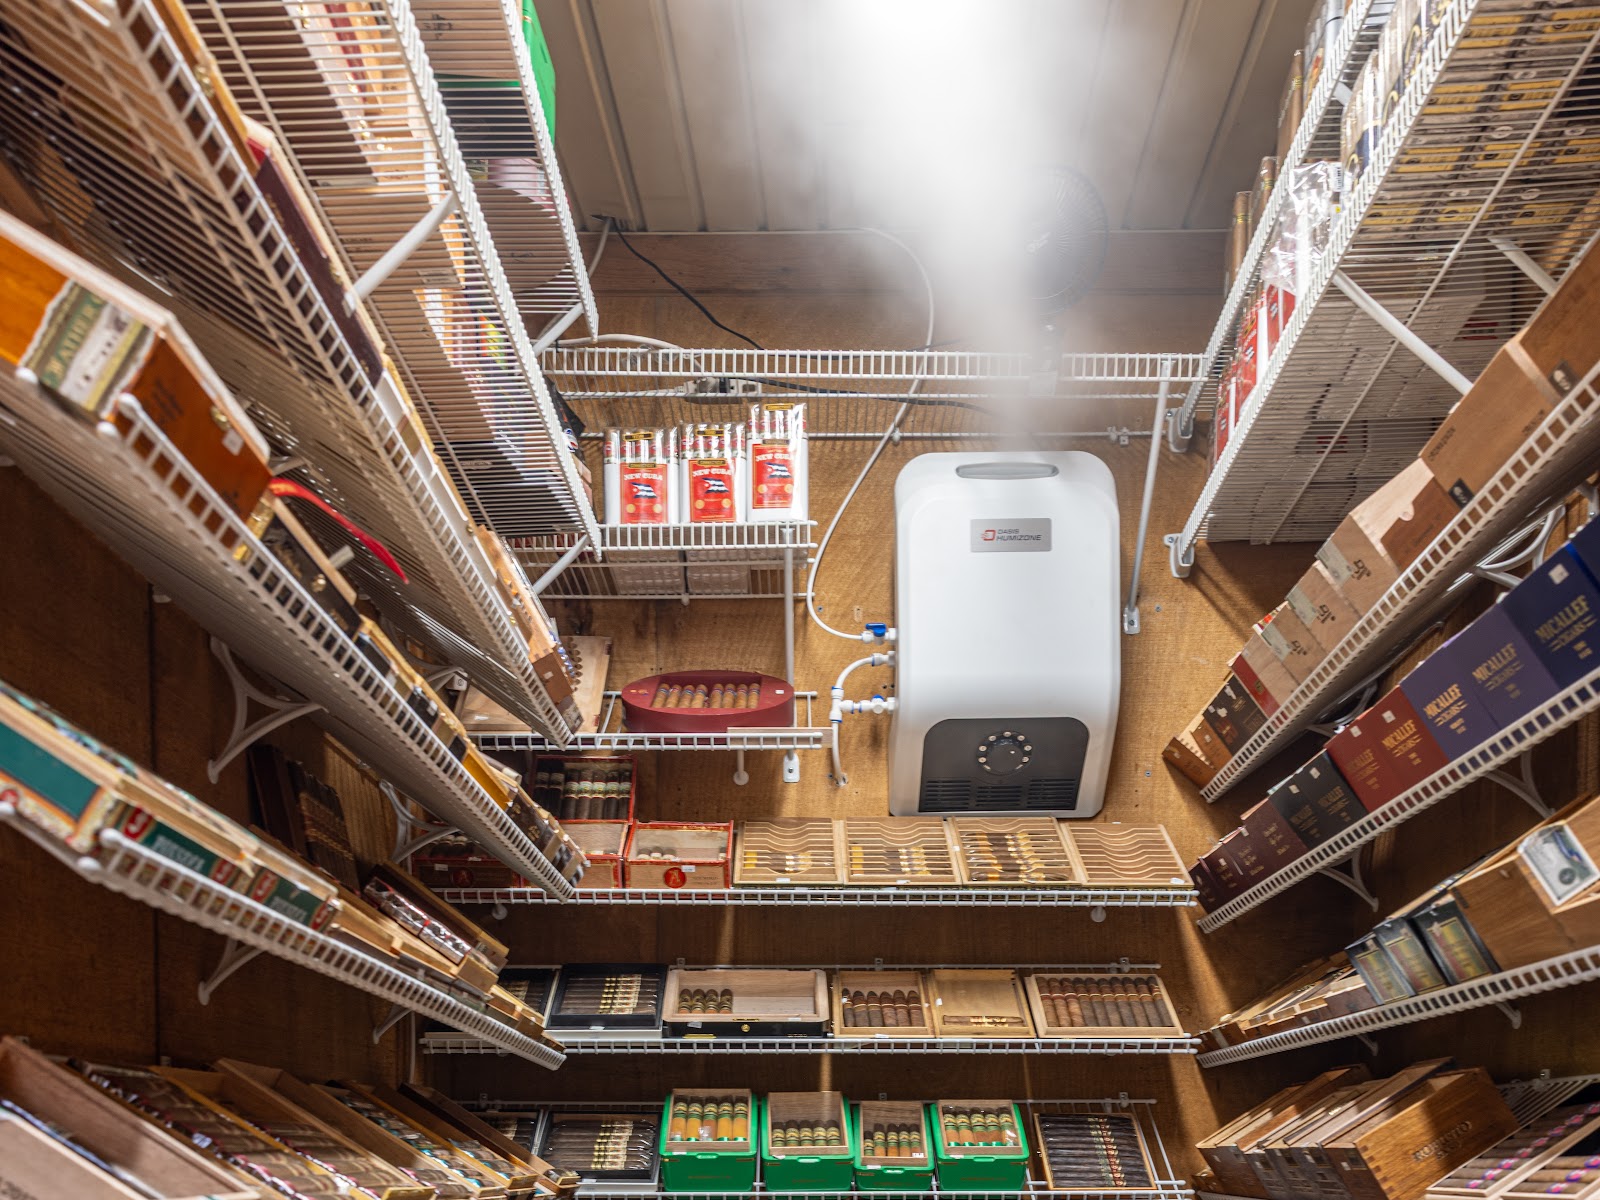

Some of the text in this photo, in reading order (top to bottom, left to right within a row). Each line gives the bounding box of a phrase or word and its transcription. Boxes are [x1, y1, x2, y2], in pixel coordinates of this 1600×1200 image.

[1535, 595, 1591, 641] MICALLEF
[1472, 643, 1518, 682] MICALLEF
[1423, 683, 1463, 718] MICALLEF
[1381, 719, 1418, 751] MICALLEF
[1413, 1120, 1473, 1162] ROBUSTO
